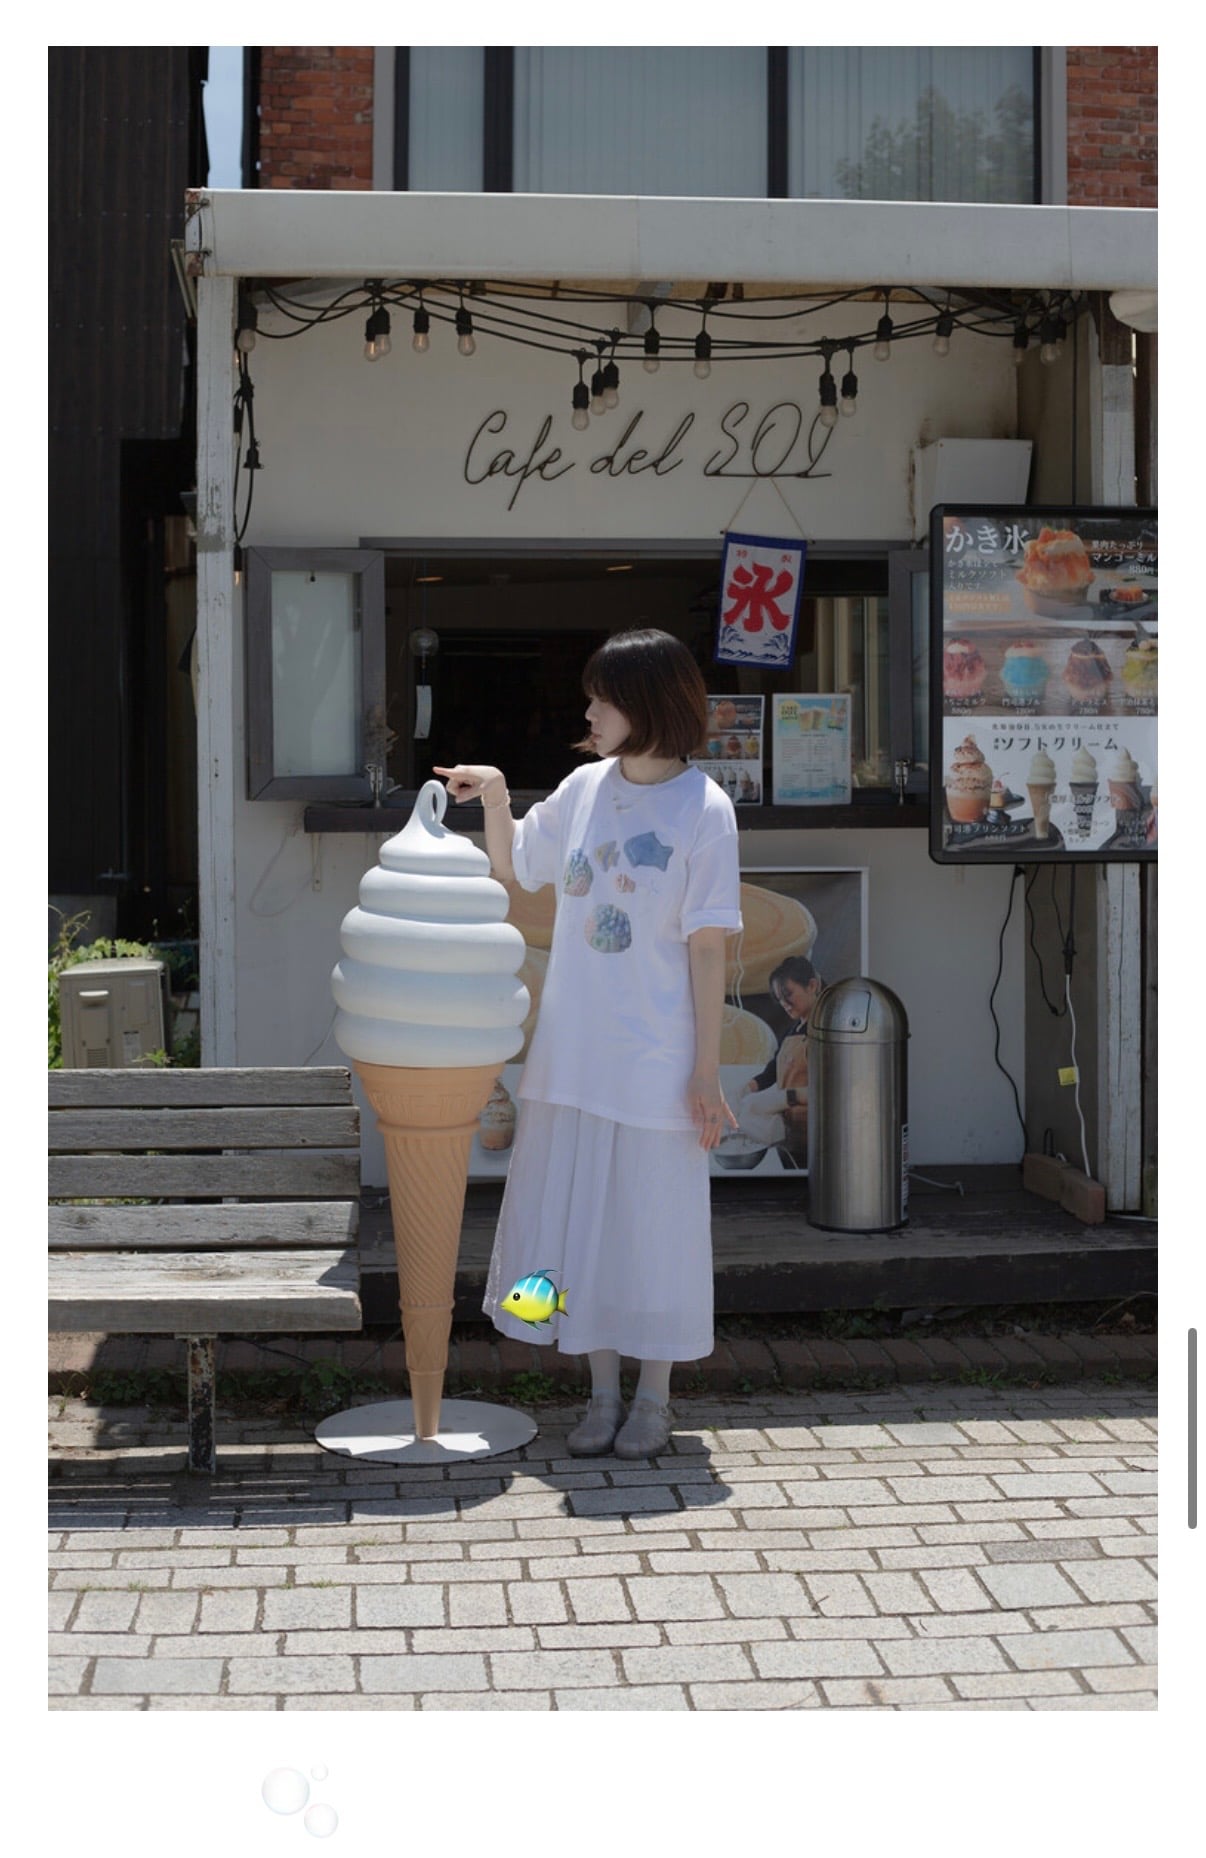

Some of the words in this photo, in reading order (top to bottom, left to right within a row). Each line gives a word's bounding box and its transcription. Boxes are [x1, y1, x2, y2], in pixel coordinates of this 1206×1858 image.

[464, 409, 576, 512] Cafe
[589, 410, 696, 478] del
[945, 524, 1030, 555] かき氷
[723, 562, 794, 634] 氷
[1001, 736, 1118, 751] ソフトクリーム
